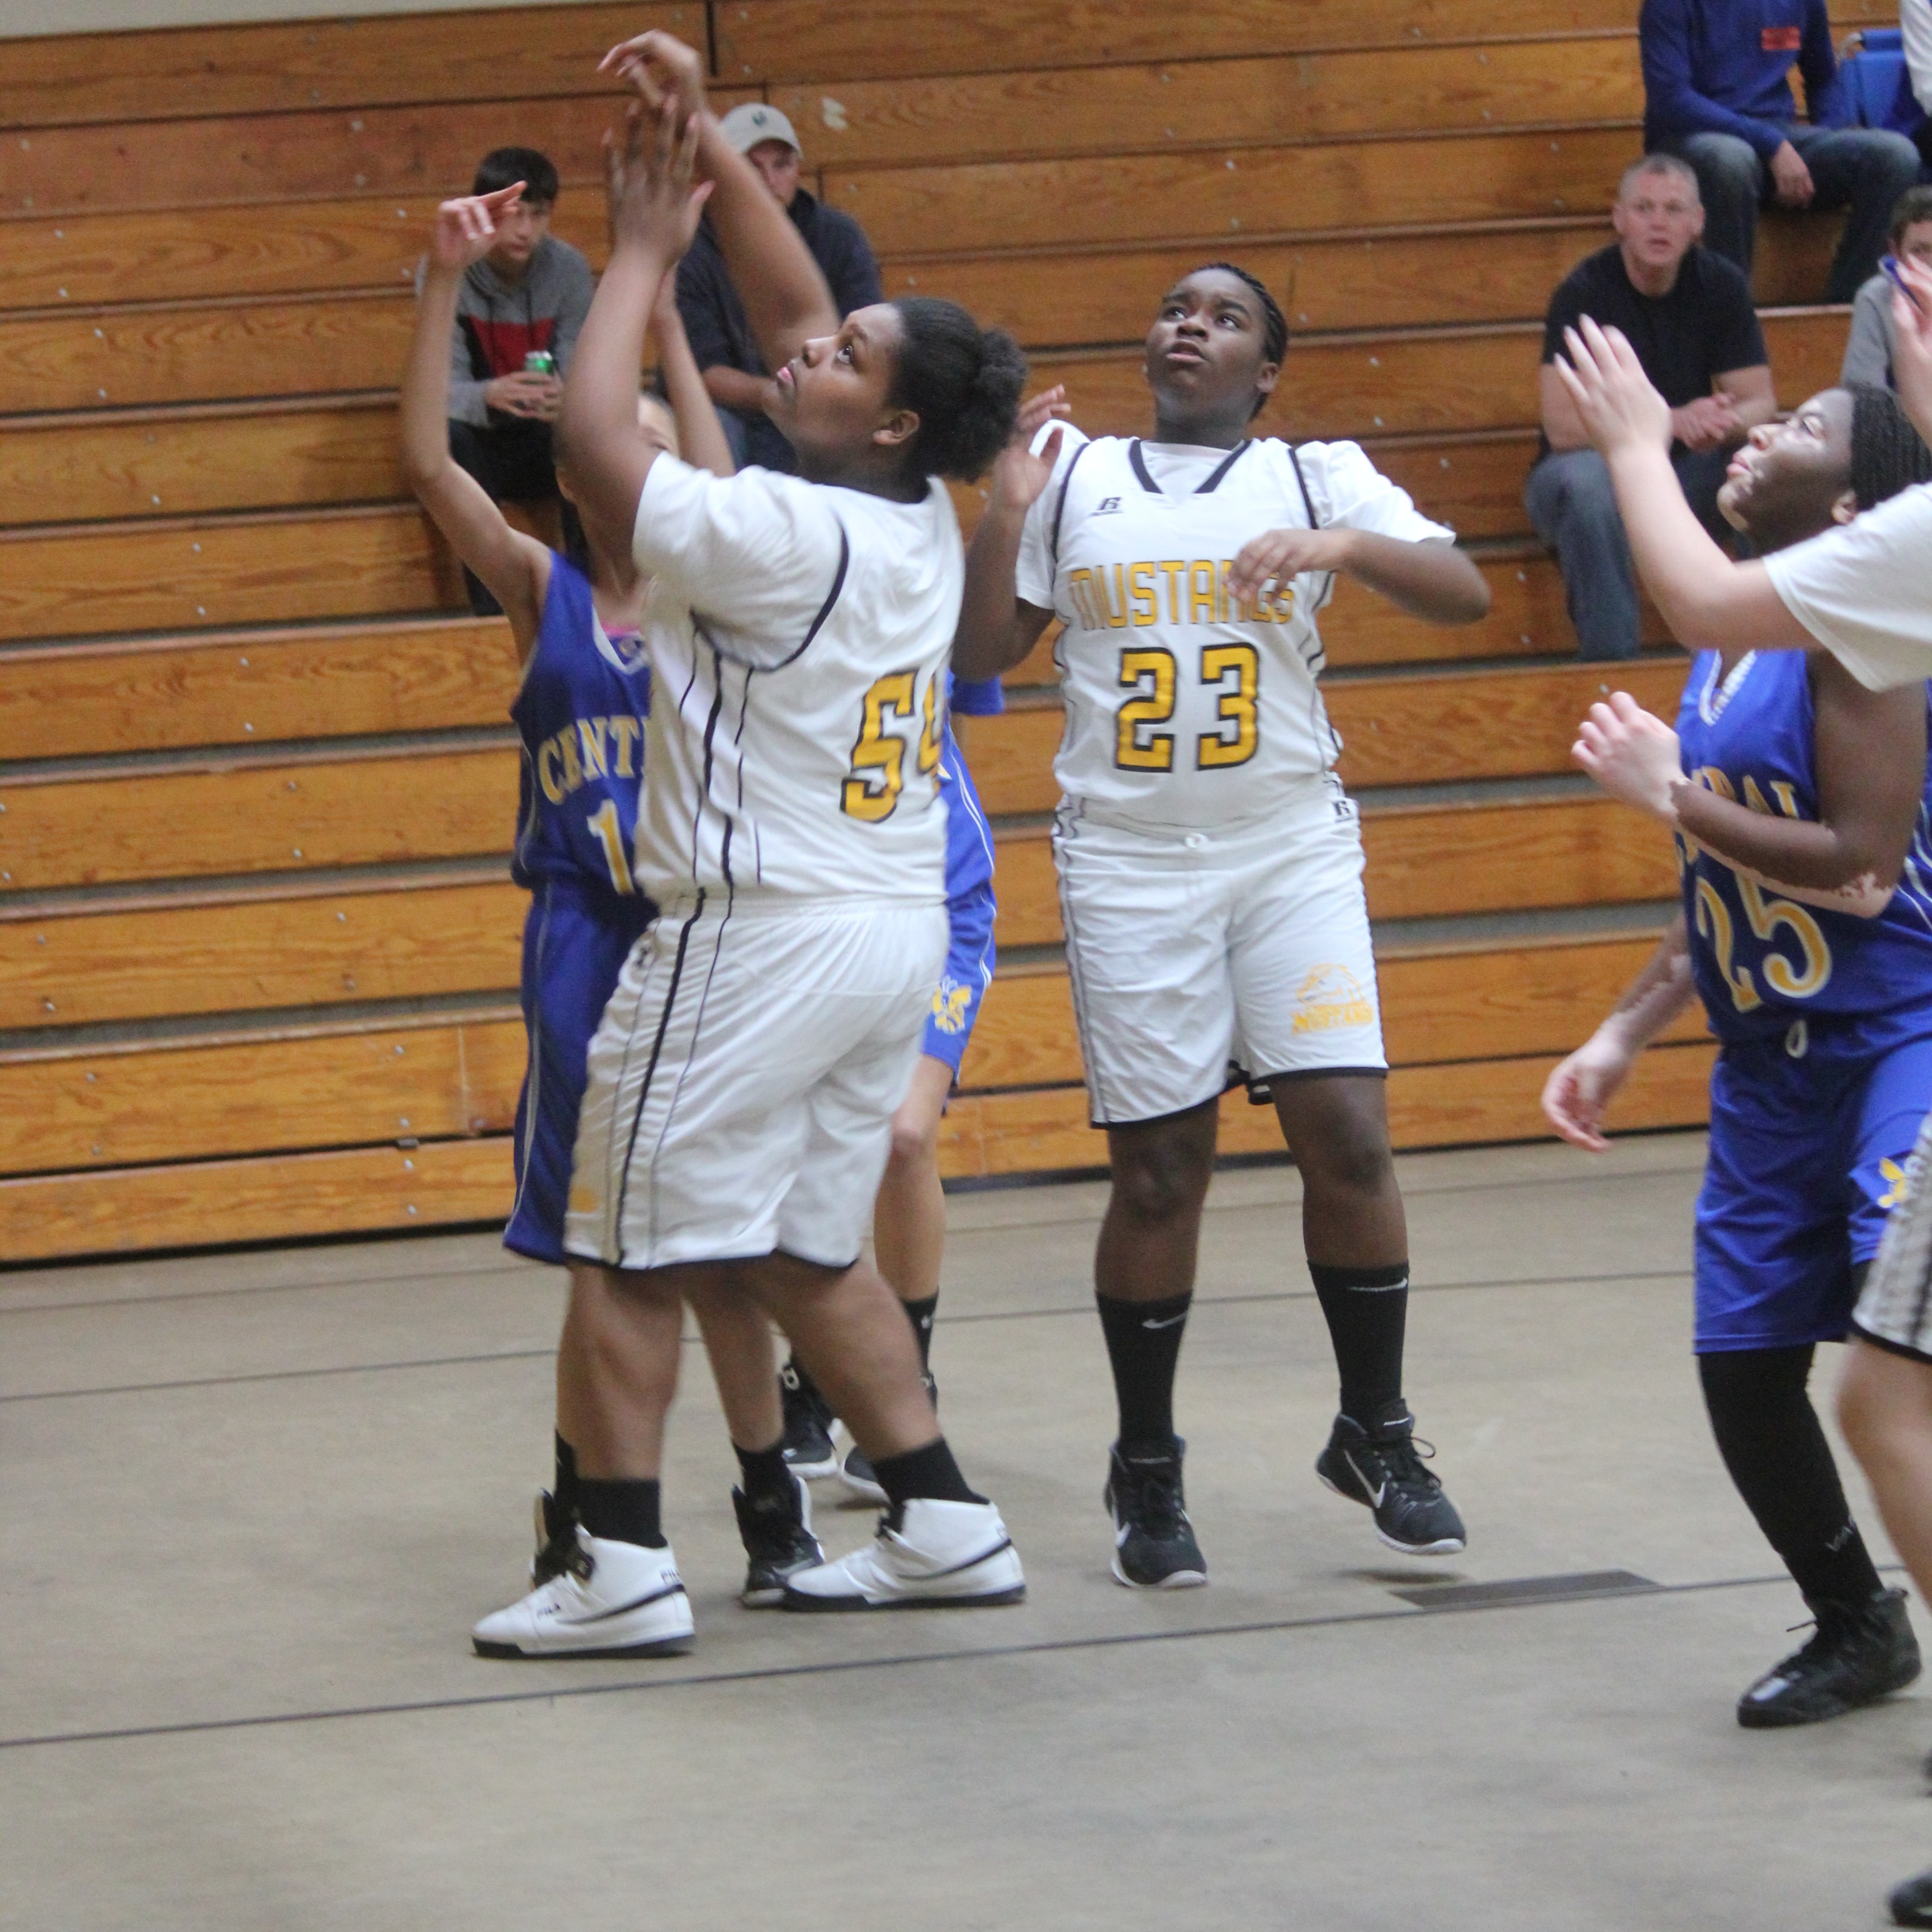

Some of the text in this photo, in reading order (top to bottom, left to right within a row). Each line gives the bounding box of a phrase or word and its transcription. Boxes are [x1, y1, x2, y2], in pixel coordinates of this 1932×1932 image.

[538, 714, 647, 805] CENT
[1115, 642, 1259, 773] 23
[1696, 870, 1832, 1013] 25
